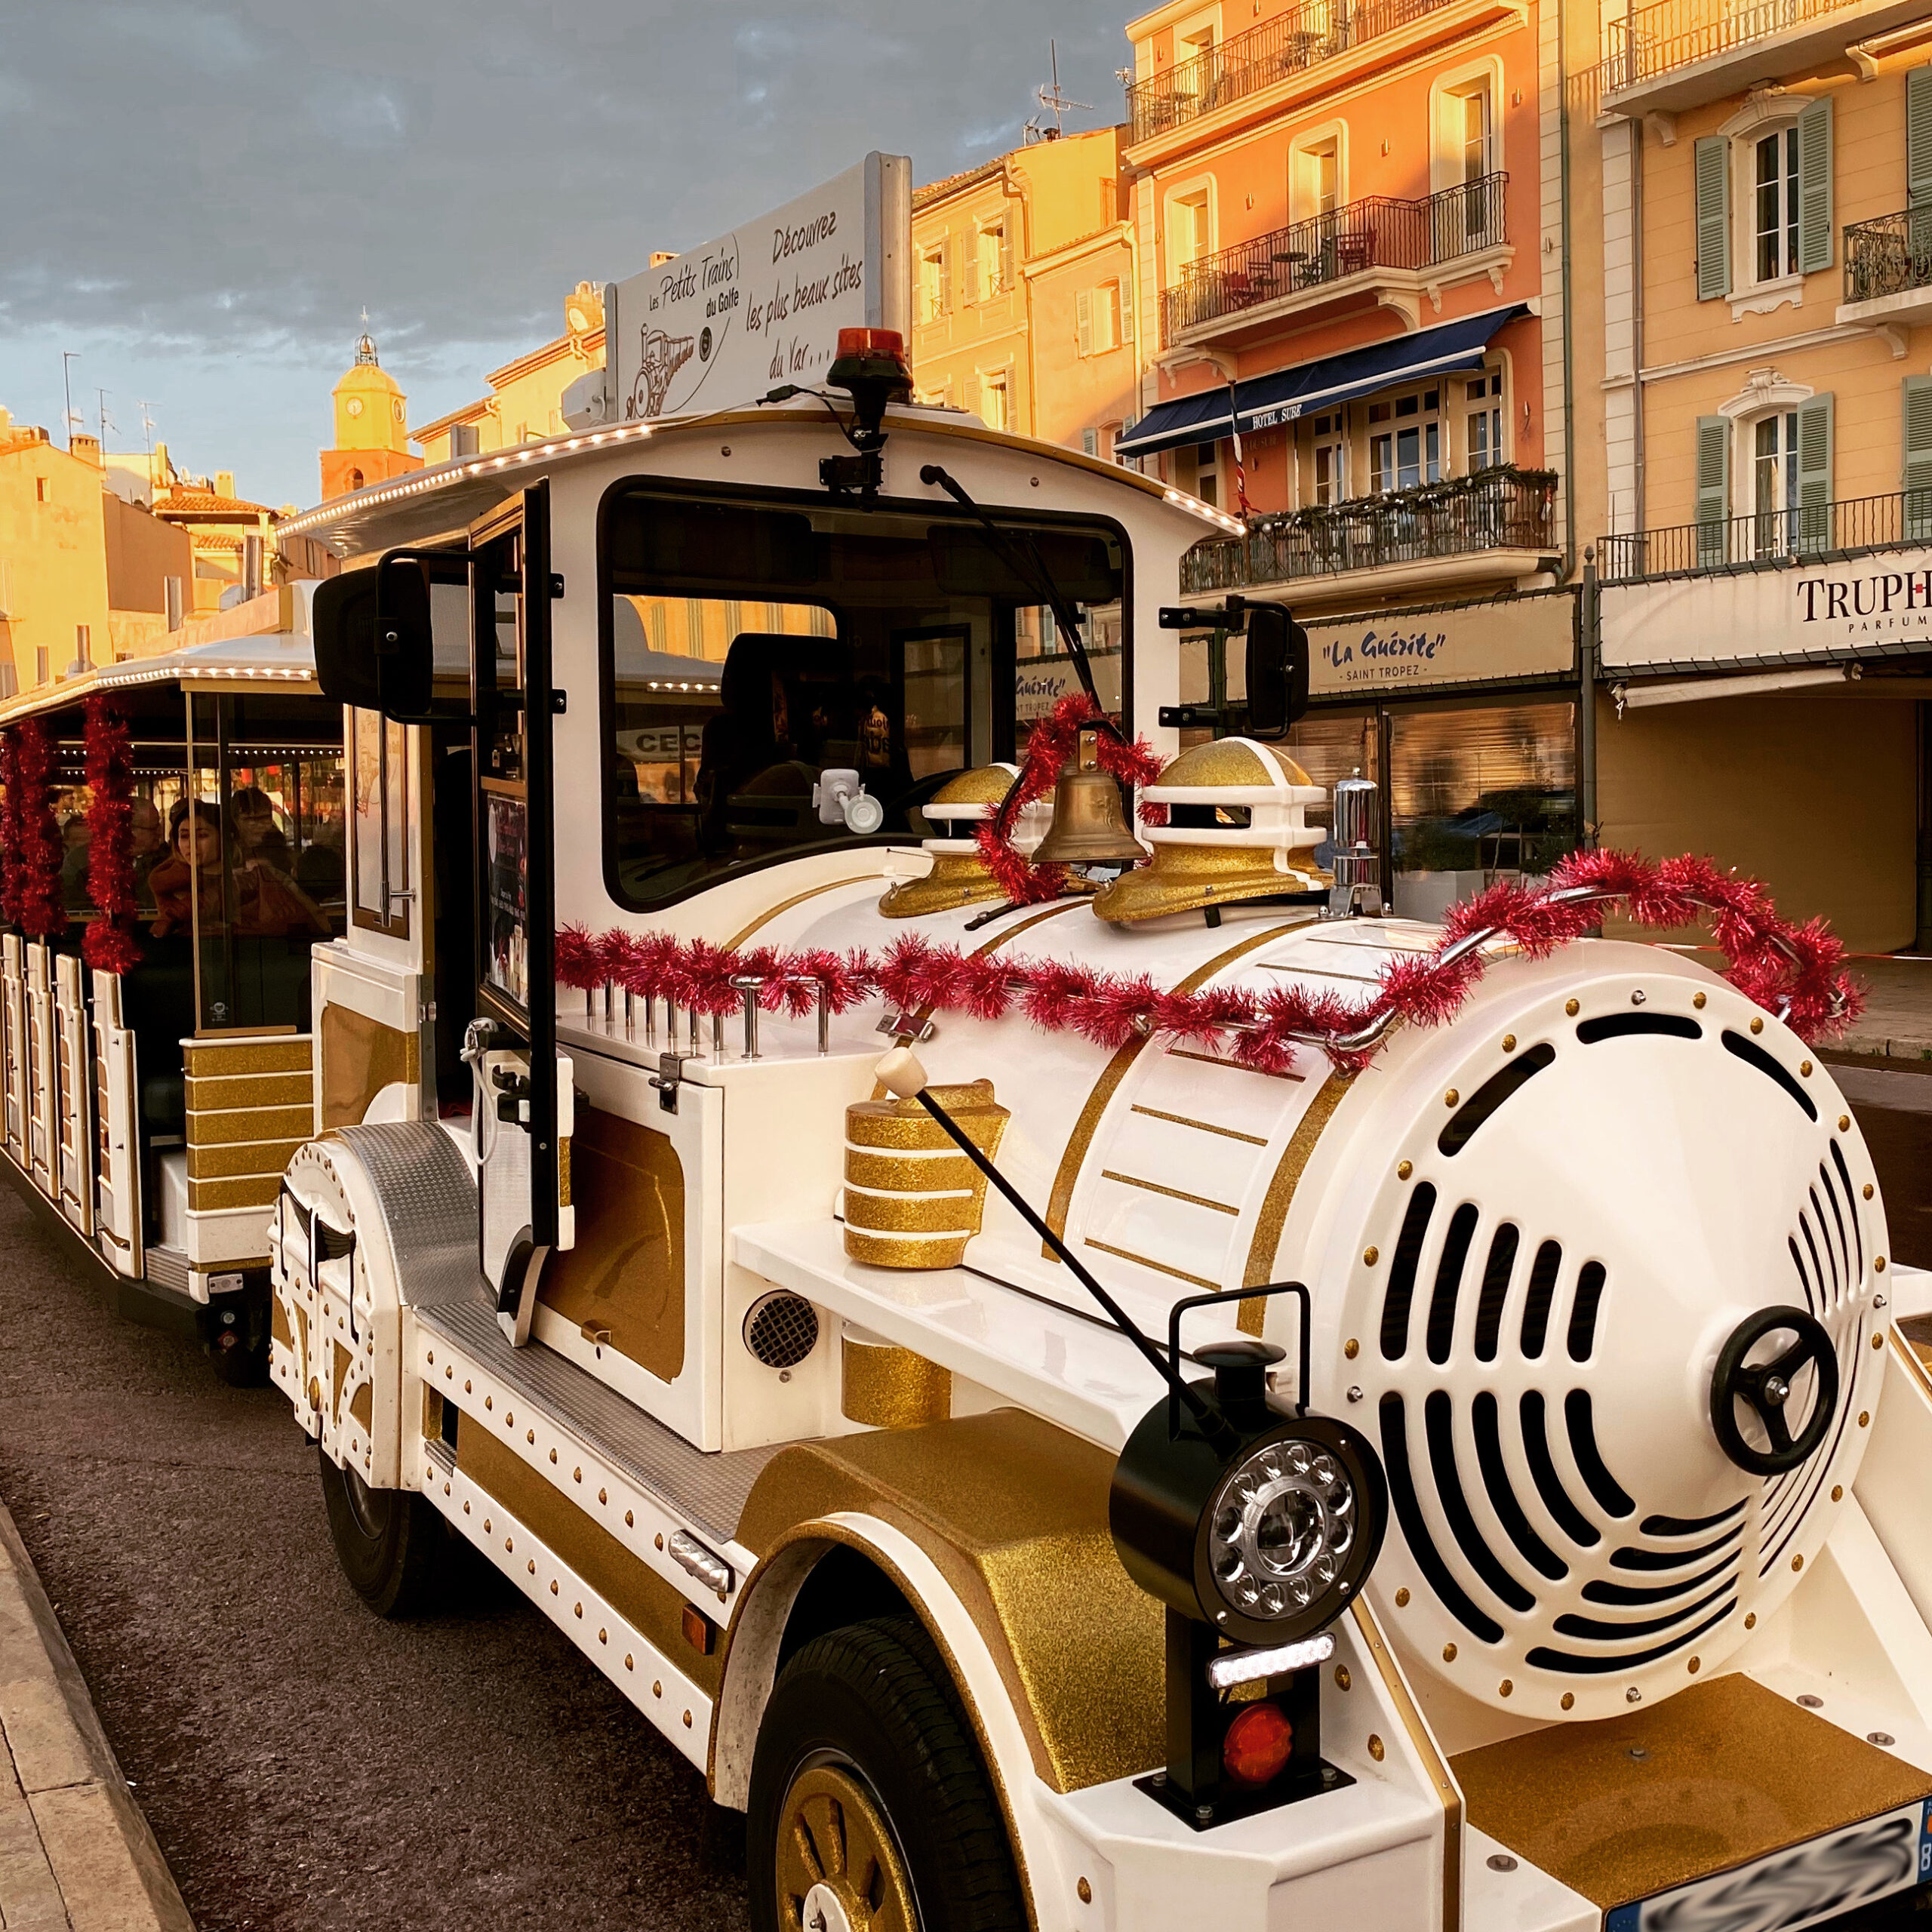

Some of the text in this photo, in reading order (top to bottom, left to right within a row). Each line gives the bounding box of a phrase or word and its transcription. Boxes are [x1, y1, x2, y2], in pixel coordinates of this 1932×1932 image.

[773, 211, 838, 265] Découvrez
[660, 264, 697, 309] Petits
[701, 247, 734, 290] Trains
[746, 253, 863, 337] les plus beaux sites
[706, 287, 740, 318] du Golfe
[769, 338, 783, 380] du
[1253, 411, 1278, 429] HOTEL
[1849, 615, 1927, 633] PARFUM
[1346, 665, 1420, 681] SAINT TROPEZ
